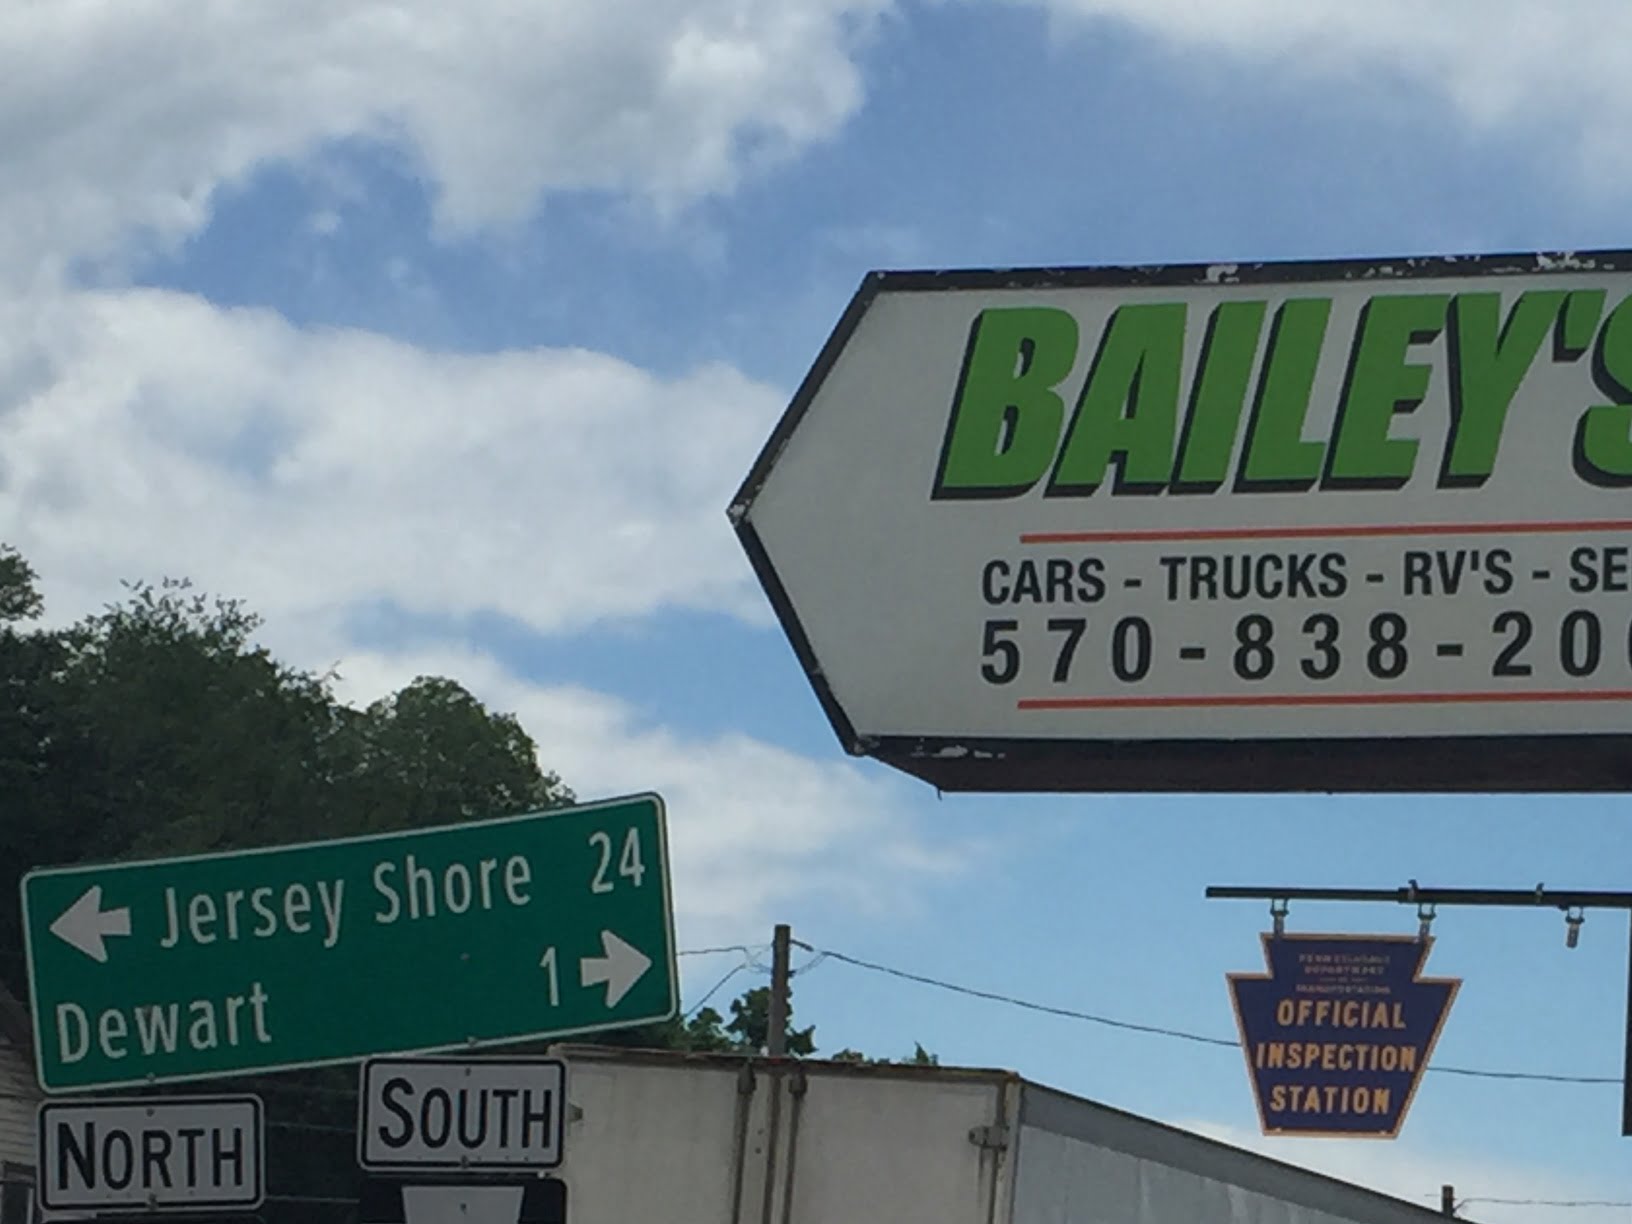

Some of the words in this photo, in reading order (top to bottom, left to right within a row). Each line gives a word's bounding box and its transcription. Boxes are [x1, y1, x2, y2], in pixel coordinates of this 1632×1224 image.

[981, 559, 1107, 605] CARS
[1159, 552, 1348, 602] TRUCKS
[1403, 547, 1514, 596] RV'S
[160, 877, 346, 950] Jersey
[373, 853, 532, 926] Shore
[588, 826, 647, 896] 24
[56, 981, 273, 1066] Dewart
[539, 945, 561, 1008] 1
[1277, 999, 1407, 1029] OFFICIAL
[1256, 1042, 1417, 1072] INSPECTION
[379, 1076, 552, 1150] SOUTH
[1270, 1084, 1391, 1115] STATION
[57, 1120, 245, 1192] NORTH
